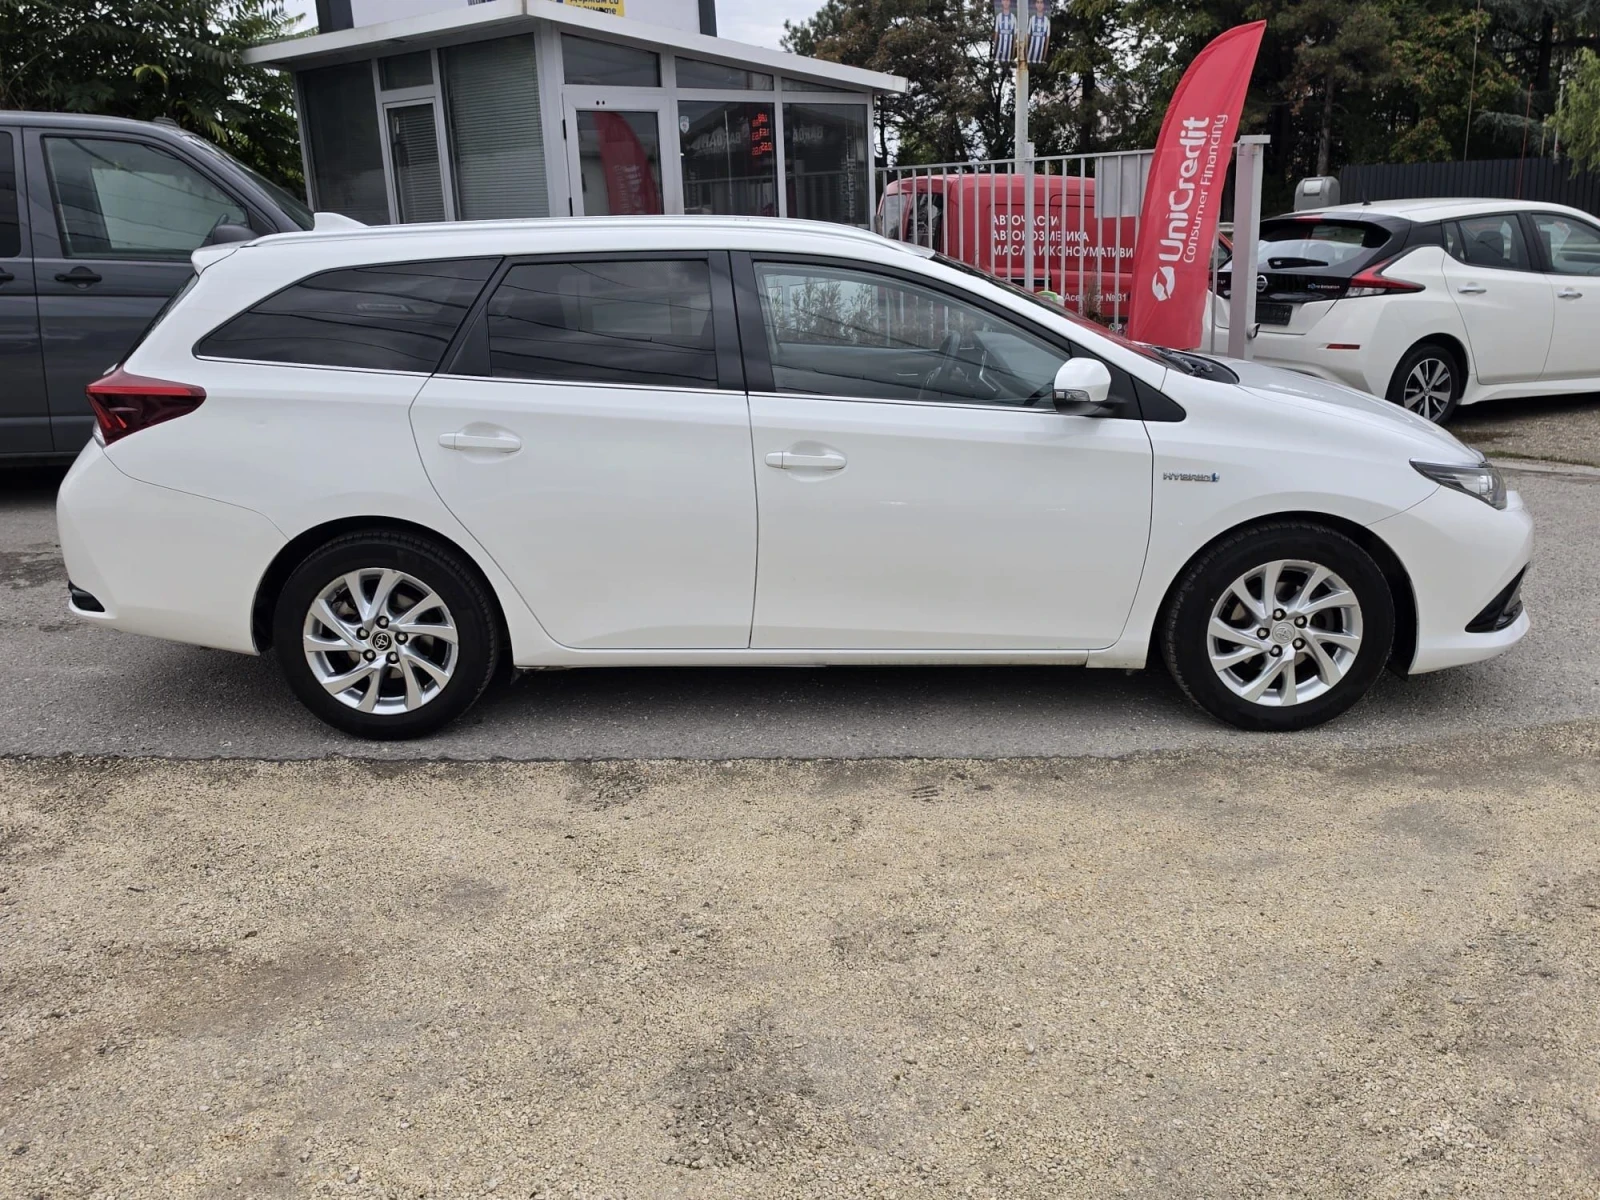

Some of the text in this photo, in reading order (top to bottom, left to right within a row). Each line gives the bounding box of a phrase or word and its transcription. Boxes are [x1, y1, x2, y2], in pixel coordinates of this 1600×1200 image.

[993, 214, 1058, 226] АВОСИ
[1158, 116, 1209, 262] UniCredit
[1183, 114, 1228, 264] Consumer Financing
[993, 230, 1089, 242] АВООЗМЕИКА
